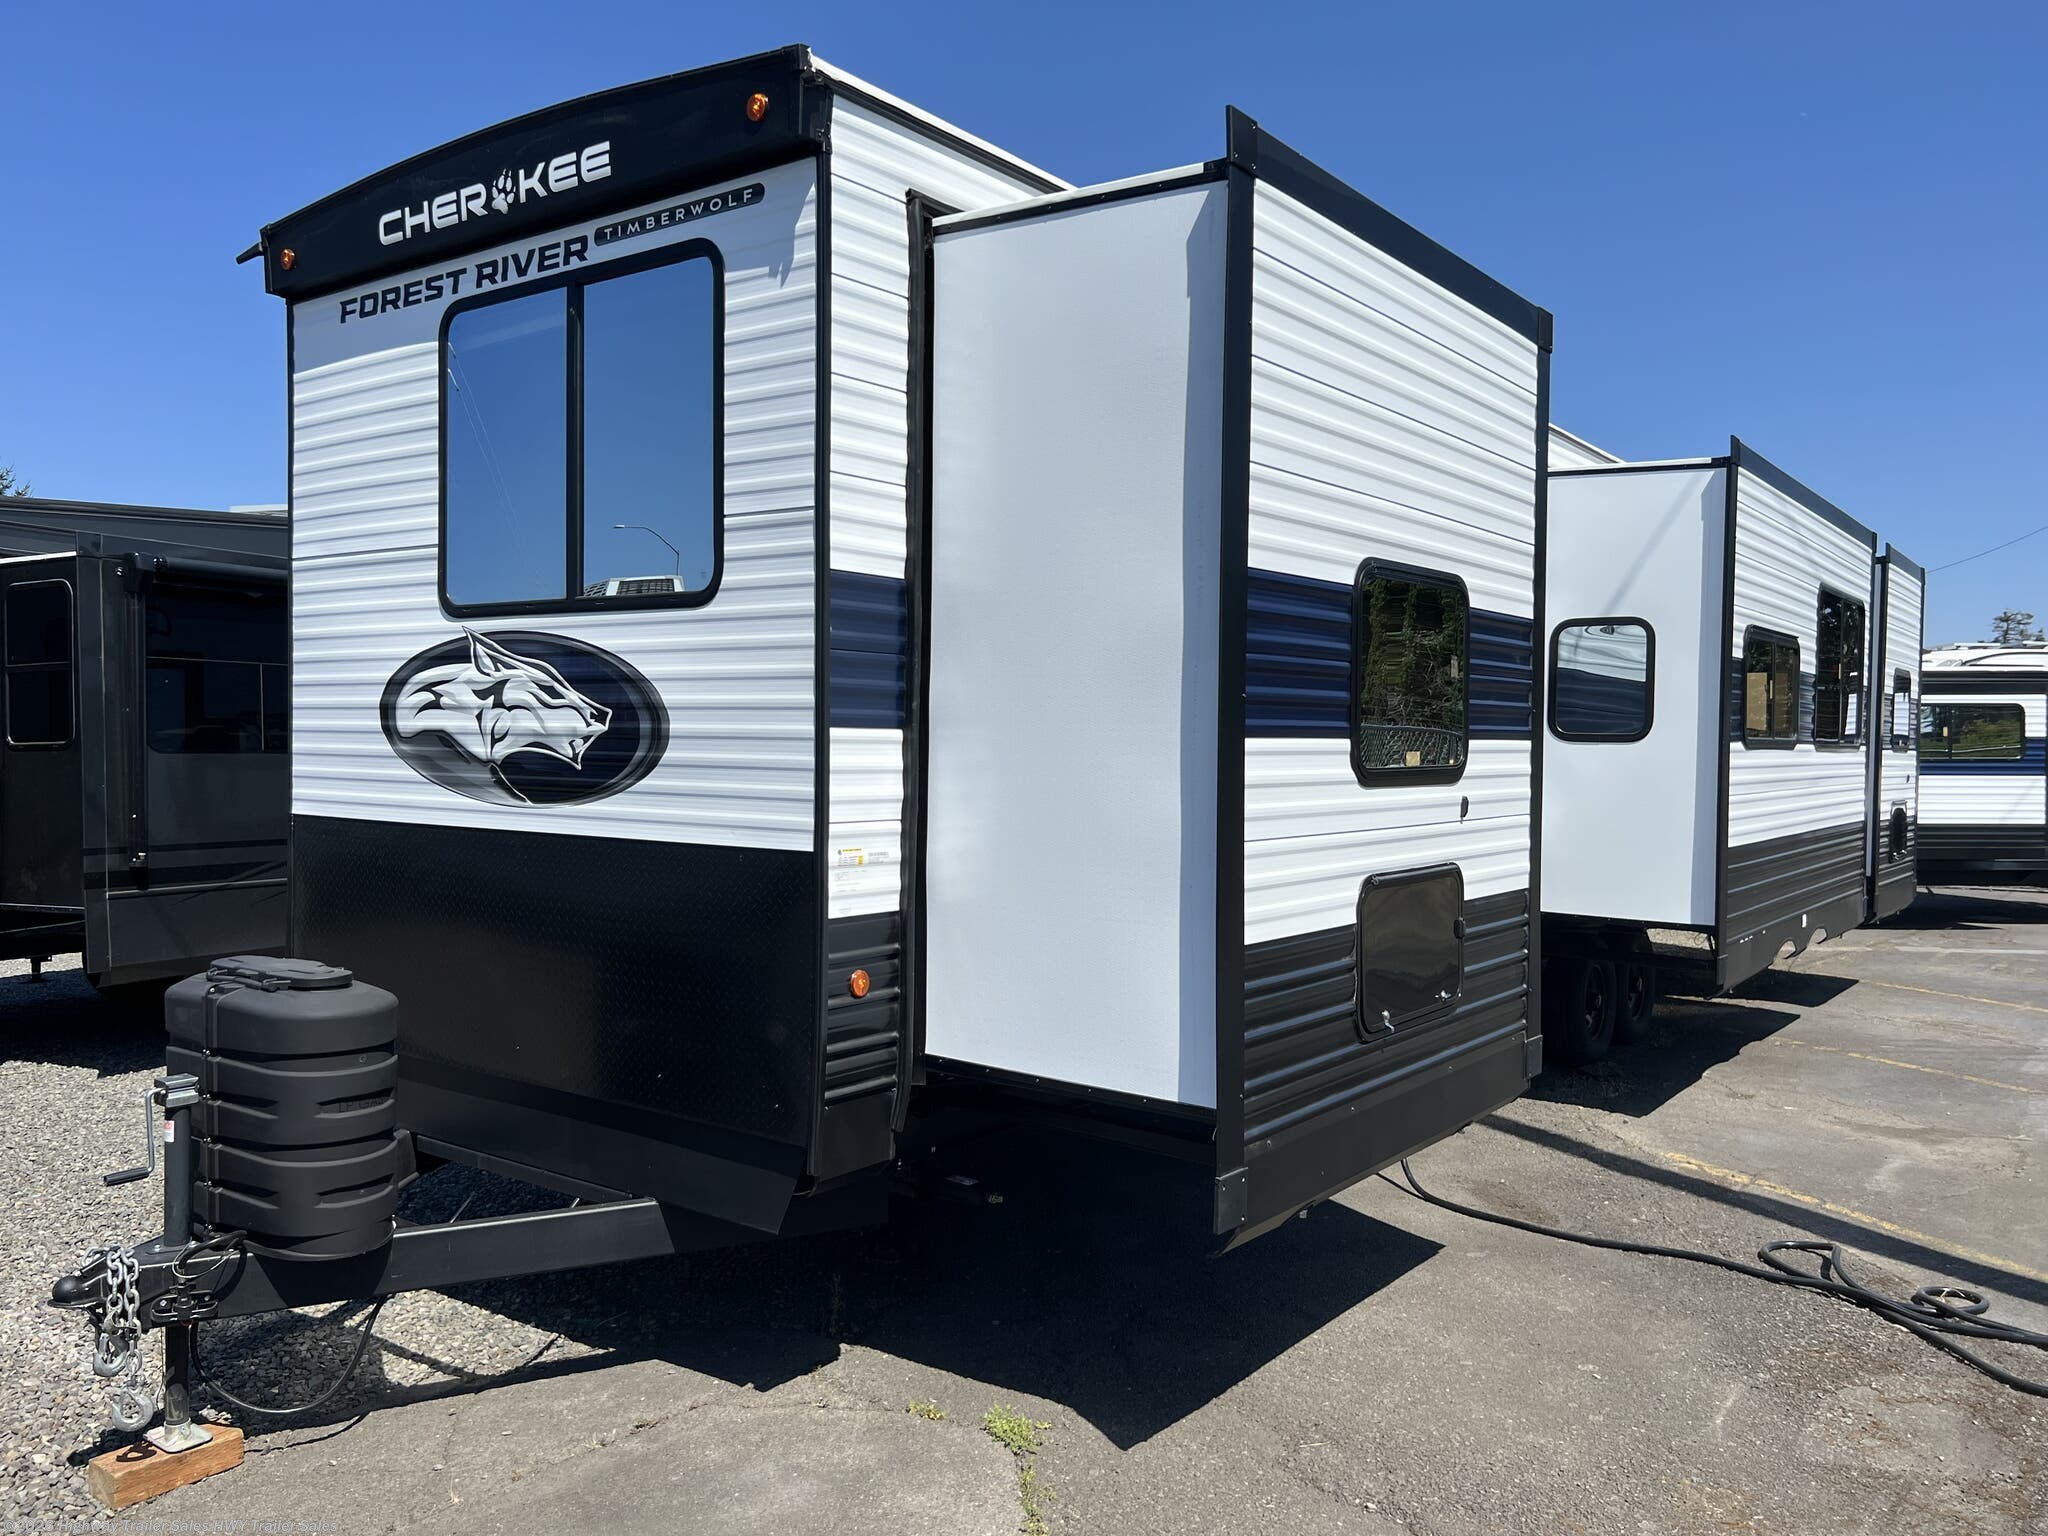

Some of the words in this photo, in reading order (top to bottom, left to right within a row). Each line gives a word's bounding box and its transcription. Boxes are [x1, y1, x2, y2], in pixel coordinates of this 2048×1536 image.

[604, 188, 753, 241] TIMBERWOLF
[339, 268, 468, 324] FOREST
[475, 234, 589, 289] RIVER
